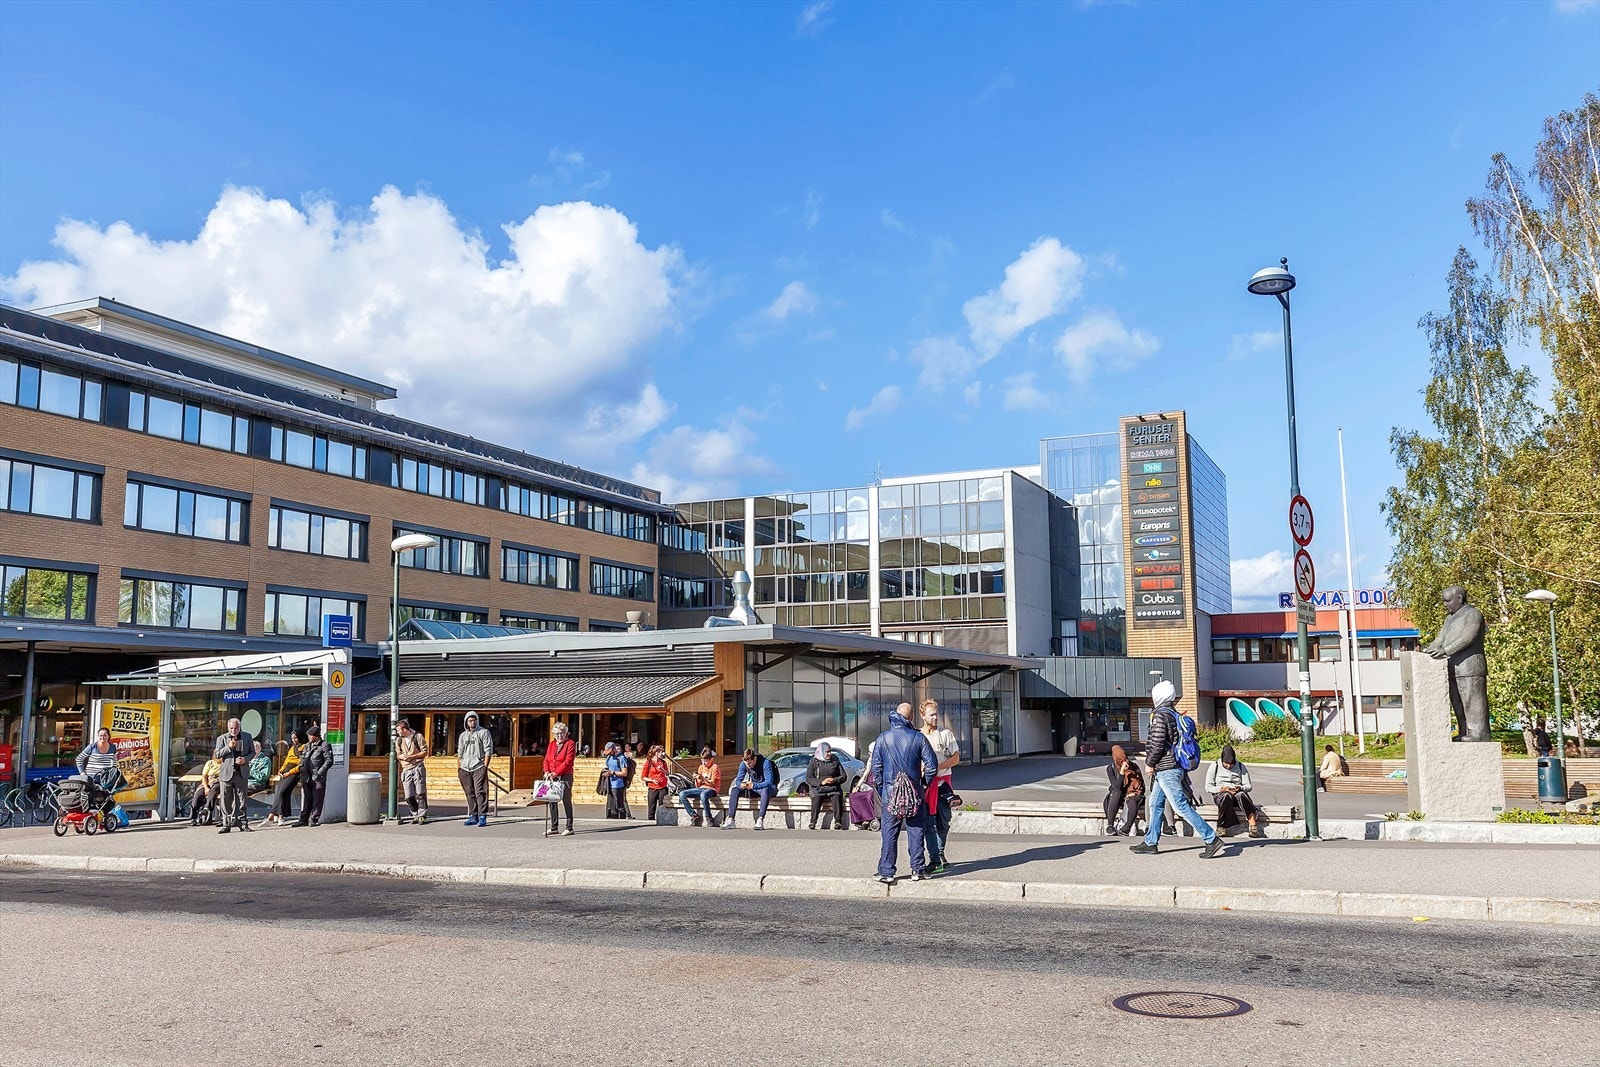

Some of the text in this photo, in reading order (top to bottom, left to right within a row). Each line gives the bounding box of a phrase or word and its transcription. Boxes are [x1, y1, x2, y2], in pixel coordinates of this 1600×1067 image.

[1129, 423, 1174, 436] FURUSET
[1133, 433, 1171, 446] SENTER
[1130, 448, 1175, 459] REMA 1000
[1145, 462, 1161, 473] DNB
[1140, 521, 1171, 531] Europris
[1293, 512, 1305, 529] 3,7
[1142, 563, 1181, 575] BAZAAR
[1142, 592, 1175, 605] Cubus
[1279, 590, 1343, 608] RMA
[333, 673, 341, 685] A
[224, 690, 250, 700] Furuset T
[113, 710, 146, 722] UTE PÅ
